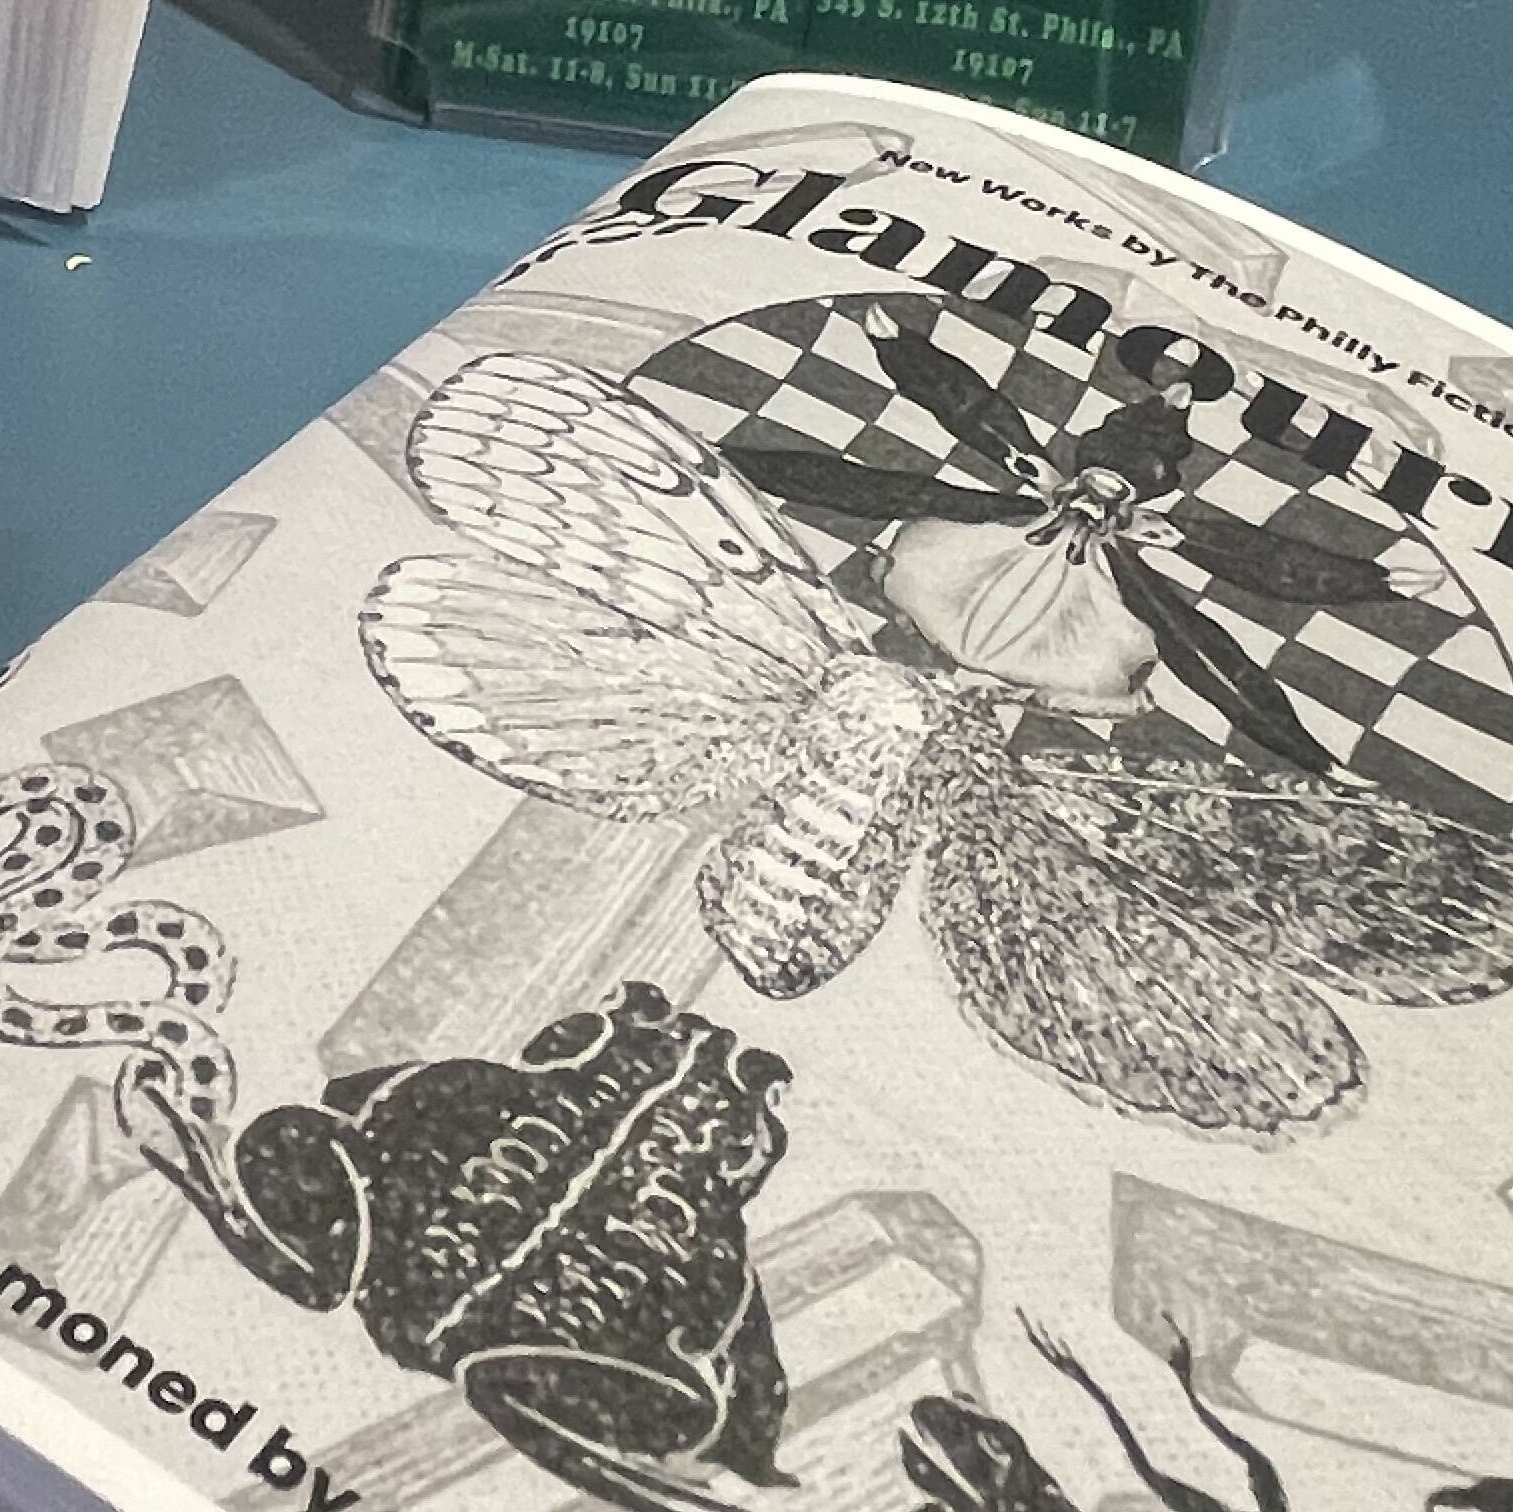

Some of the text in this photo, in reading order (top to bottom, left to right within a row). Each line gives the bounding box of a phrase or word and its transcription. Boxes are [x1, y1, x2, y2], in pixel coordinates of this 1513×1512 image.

[565, 16, 645, 52] 19107
[989, 6, 1029, 39] St.
[1147, 27, 1184, 60] PA
[626, 62, 677, 96] Sun
[688, 74, 745, 101] 11-
[951, 48, 1035, 86] 19107
[877, 149, 971, 185] New
[981, 178, 1115, 241] Works
[1121, 233, 1181, 266] by
[1189, 260, 1268, 308] The
[1274, 304, 1401, 374] Philly
